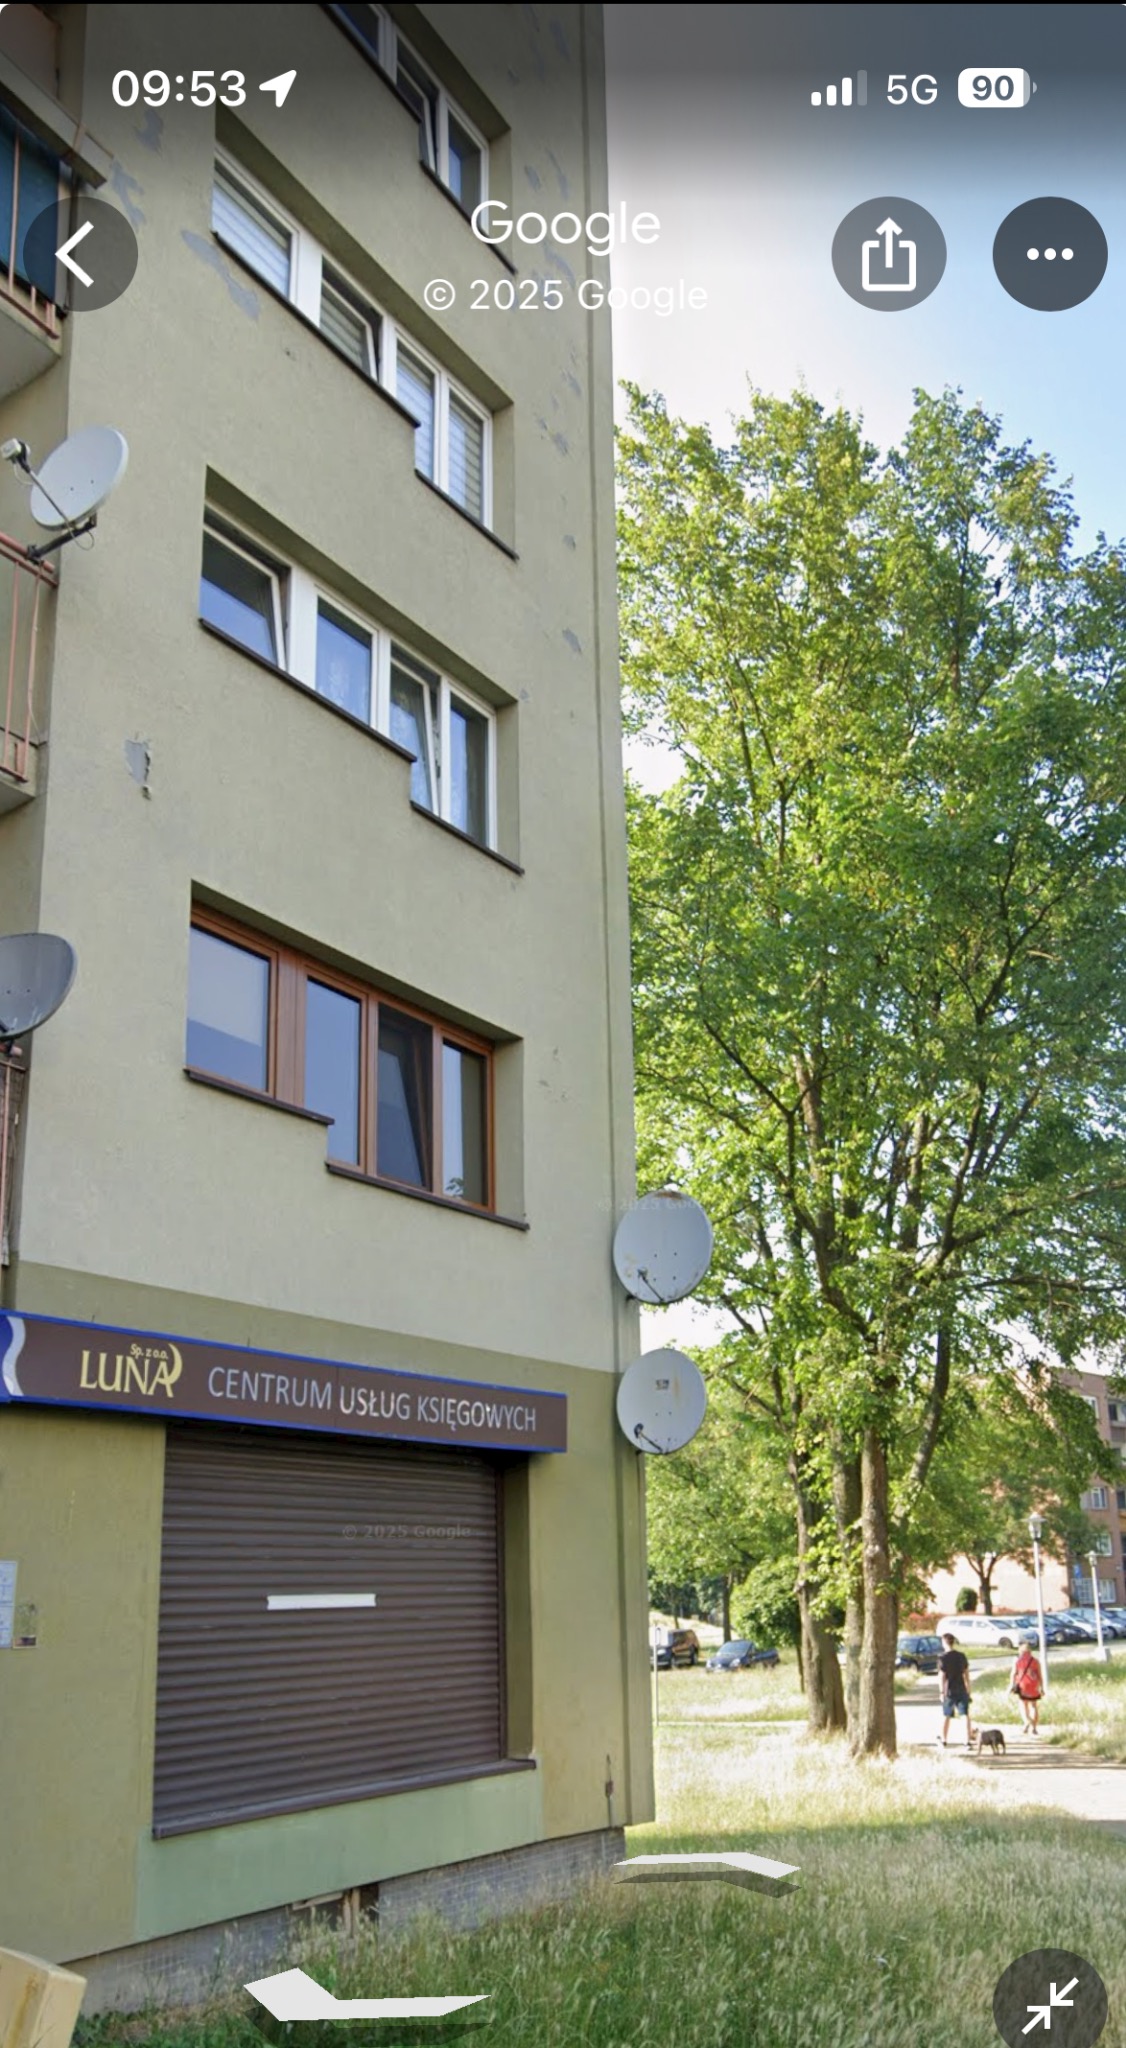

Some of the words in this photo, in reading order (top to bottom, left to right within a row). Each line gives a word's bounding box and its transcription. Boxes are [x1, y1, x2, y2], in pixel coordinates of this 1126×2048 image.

[80, 1348, 180, 1398] LUNA
[129, 1343, 144, 1359] Sp.
[208, 1366, 332, 1411] CENTRUM
[339, 1385, 411, 1420] USŁUG
[417, 1395, 537, 1431] KSIĘGOWYCH
